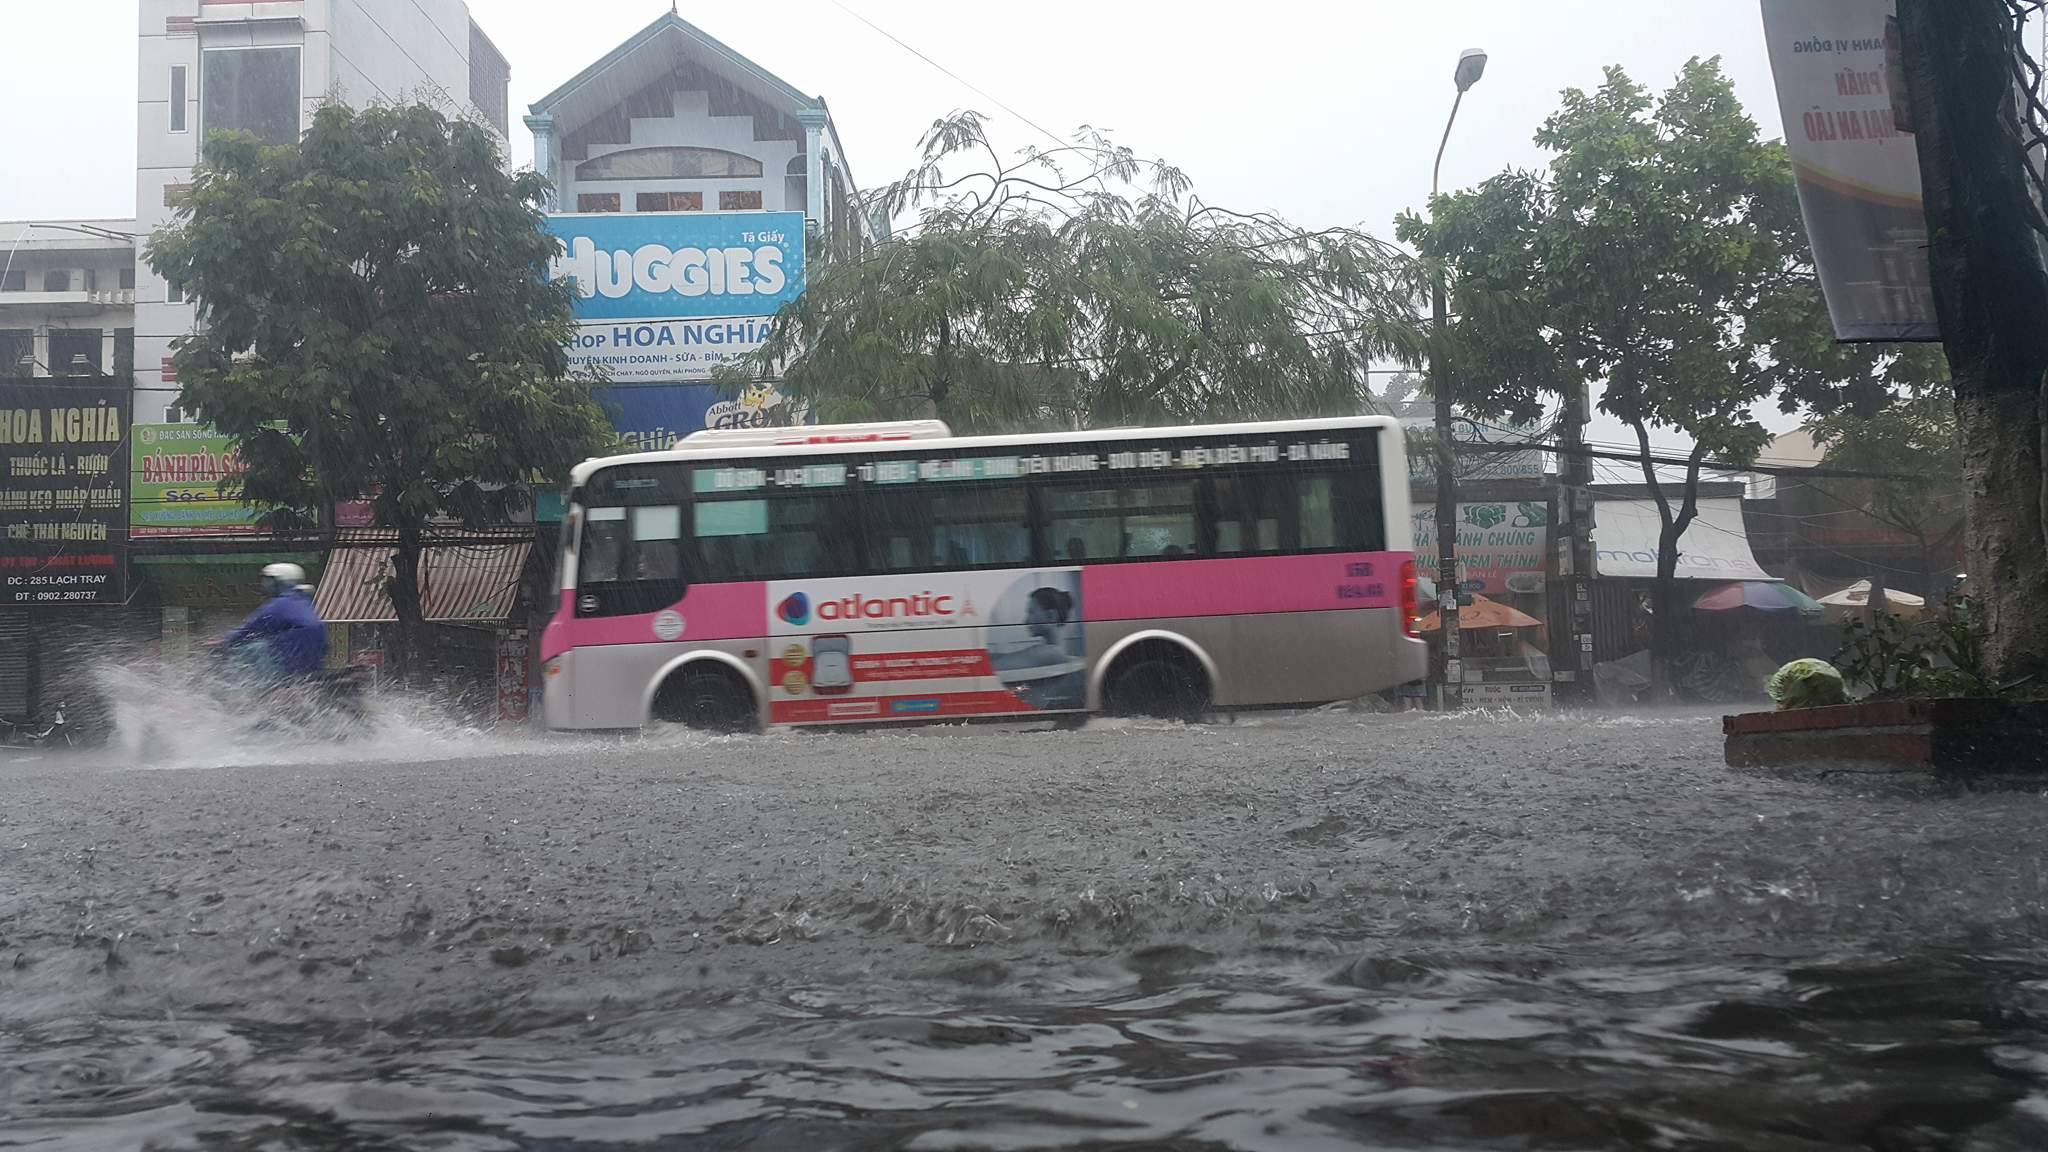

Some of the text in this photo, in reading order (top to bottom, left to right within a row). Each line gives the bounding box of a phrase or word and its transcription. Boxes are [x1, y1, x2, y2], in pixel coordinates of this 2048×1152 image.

[758, 229, 785, 244] Giấy
[549, 236, 786, 298] HUGGIES
[568, 319, 772, 348] HOP HOA NGHĨA
[601, 355, 628, 365] KINH
[629, 354, 668, 364] DOANH
[675, 351, 697, 363] SỮA
[708, 401, 741, 416] Abbott
[0, 399, 120, 444] HOA NGHĨA
[10, 450, 49, 476] THUỐC
[51, 453, 66, 475] LÁ
[142, 447, 188, 484] BÁNH
[190, 445, 218, 483] PÍA
[62, 519, 107, 541] NGUYÊN
[30, 576, 48, 585] 285
[49, 575, 77, 586] LẠCH
[80, 575, 107, 584] TRAY
[37, 591, 97, 601] 0902.280737
[816, 590, 953, 621] atlantic
